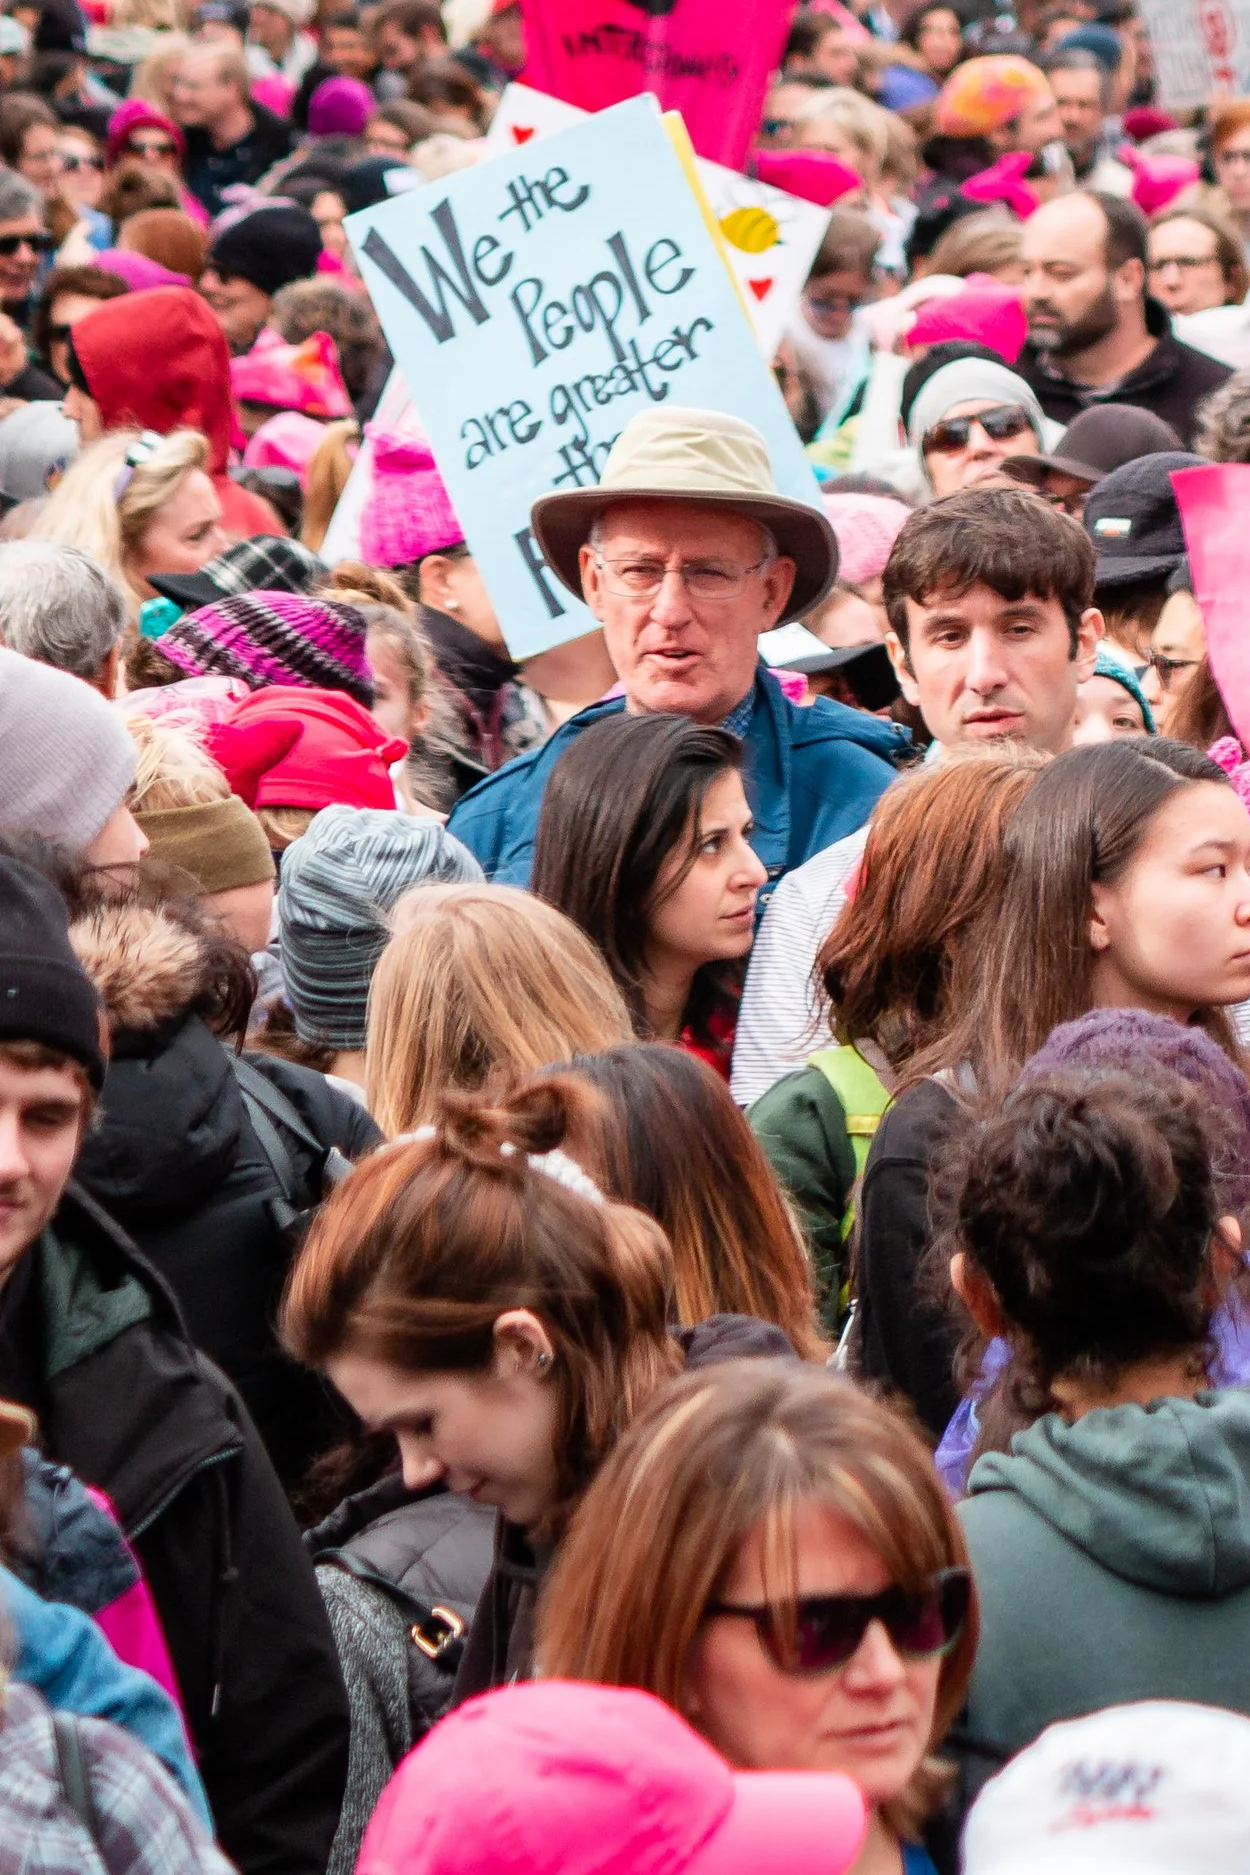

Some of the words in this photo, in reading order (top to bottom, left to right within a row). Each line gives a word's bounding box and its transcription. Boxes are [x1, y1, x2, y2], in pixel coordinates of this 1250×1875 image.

[361, 197, 514, 344] We
[498, 166, 591, 232] the
[510, 230, 697, 368] People
[460, 400, 543, 470] are
[549, 317, 715, 452] greater
